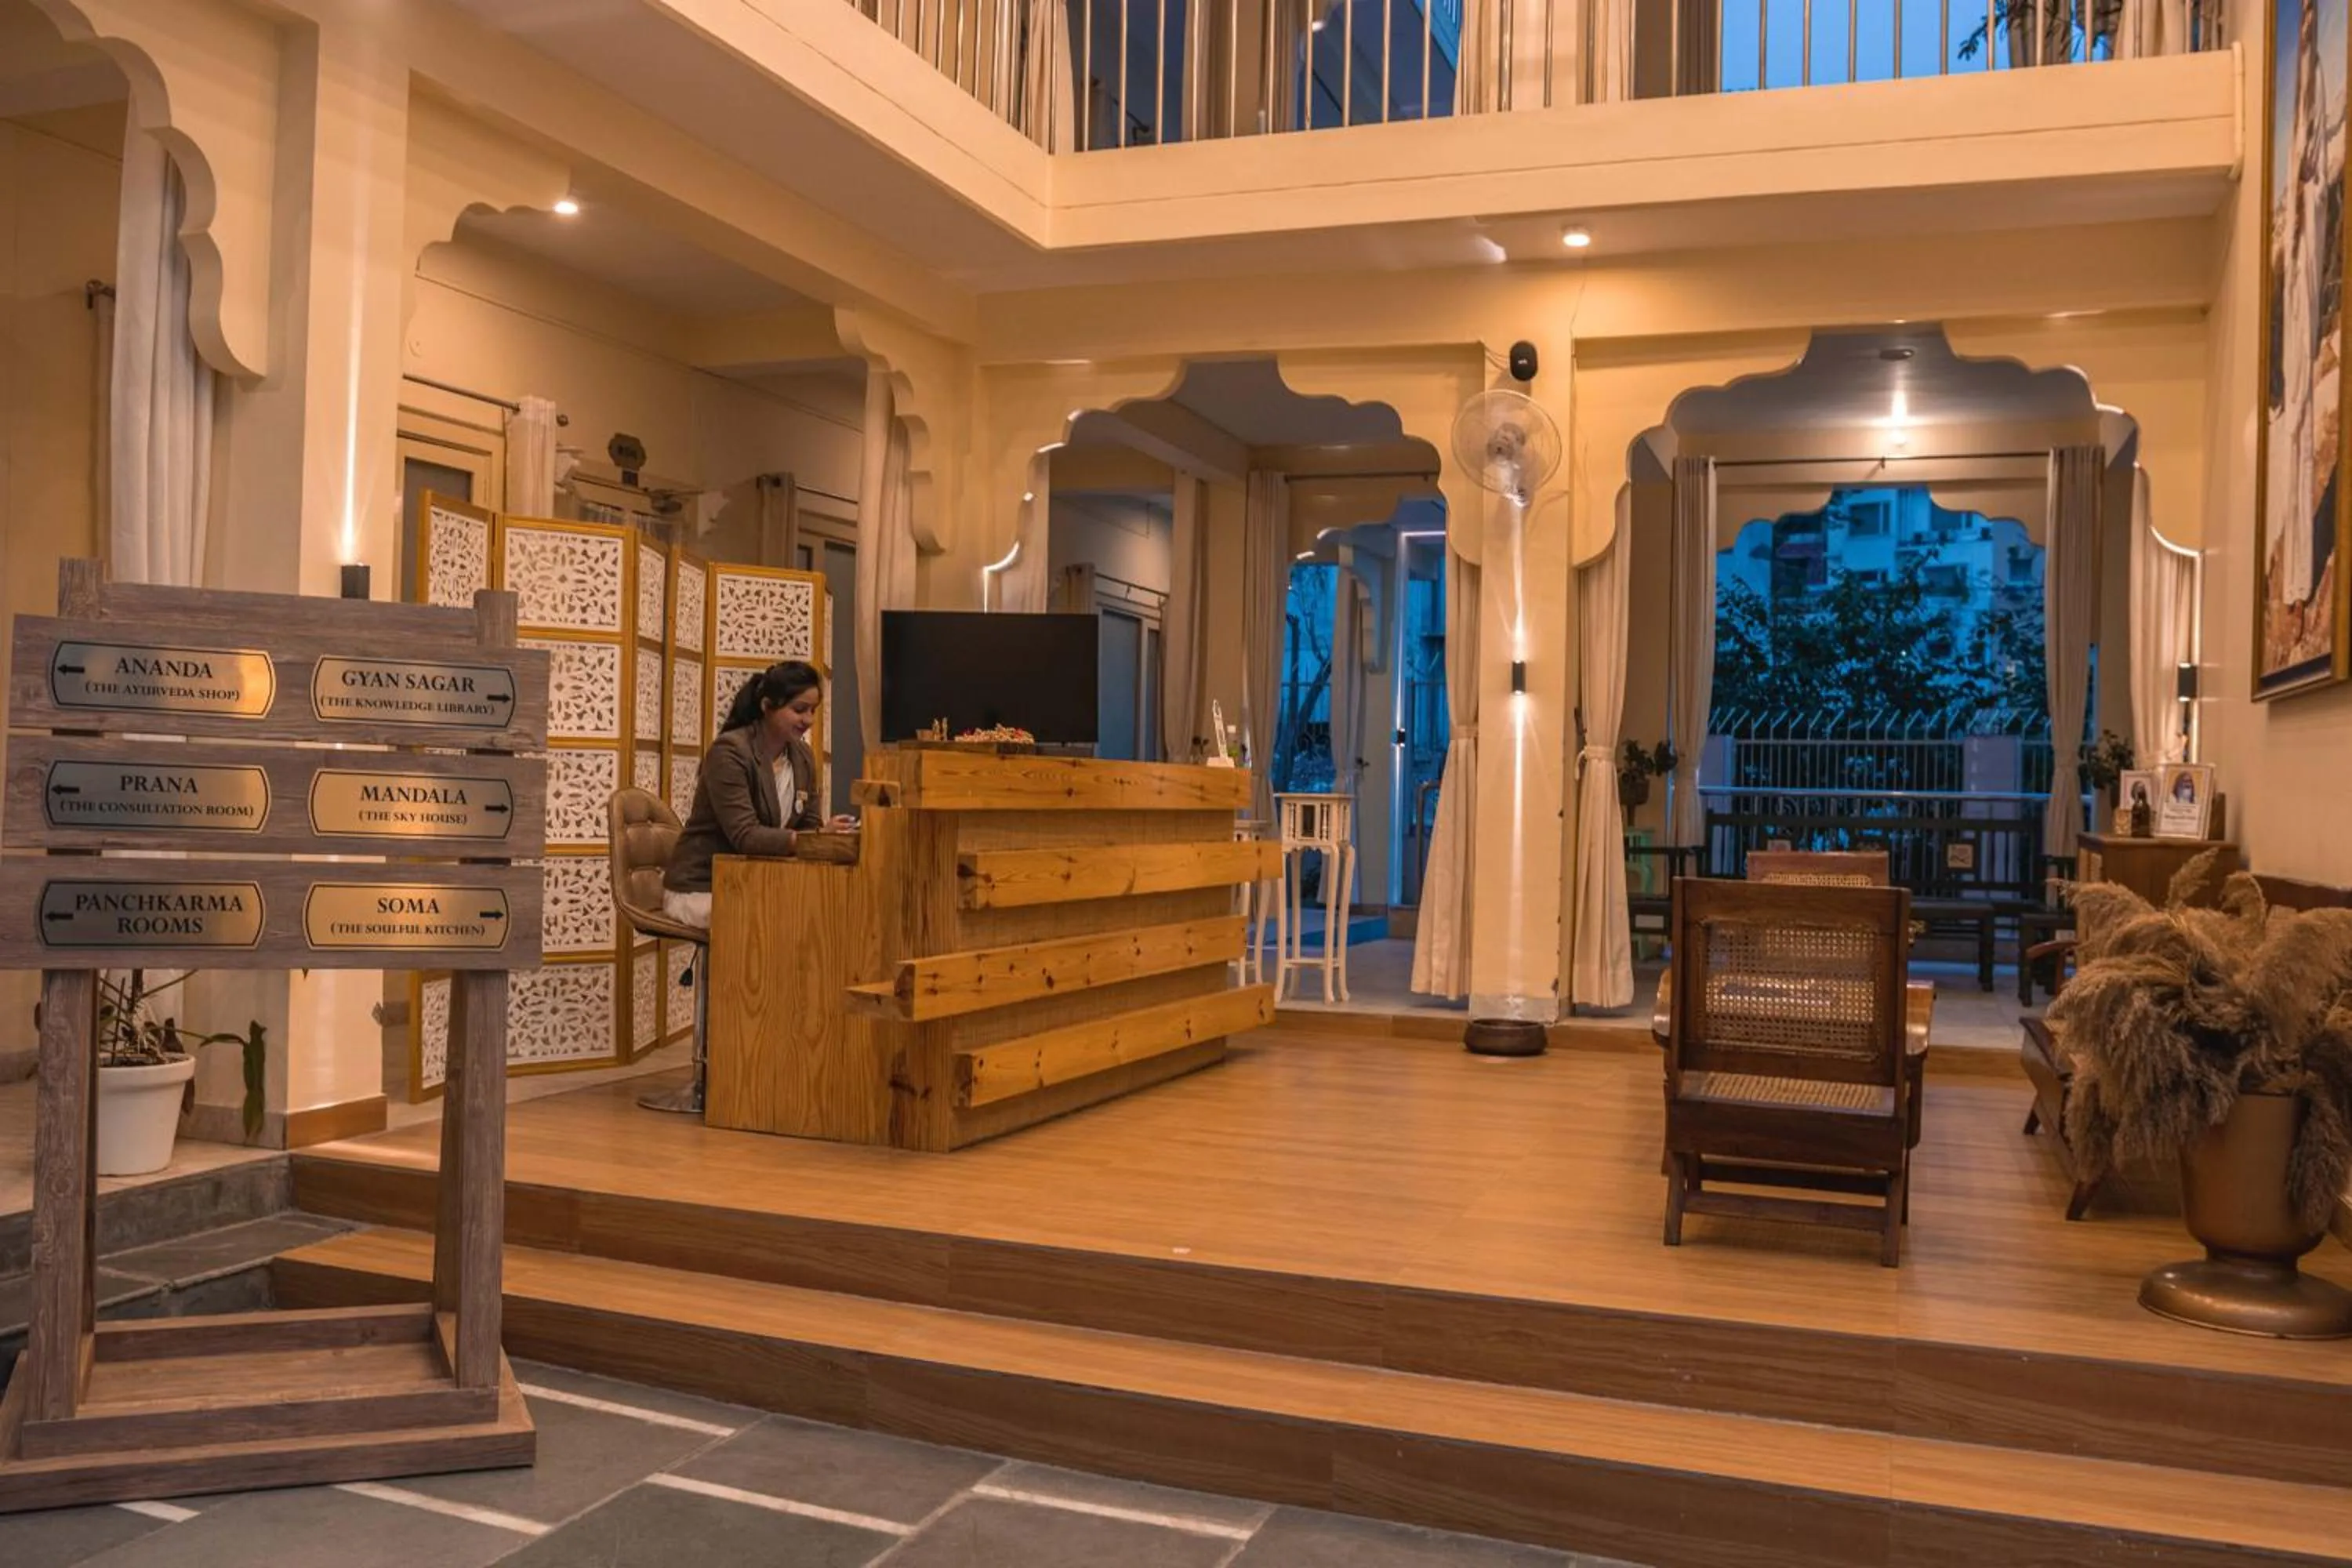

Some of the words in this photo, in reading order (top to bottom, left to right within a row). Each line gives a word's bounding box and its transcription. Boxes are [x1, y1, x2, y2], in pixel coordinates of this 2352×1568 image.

[114, 657, 213, 679] ANANDA
[341, 669, 400, 688] GYAN
[405, 673, 476, 693] SAGAR
[85, 681, 118, 695] (THE
[125, 683, 195, 699] AYURVEDA
[198, 688, 240, 702] SHOP)
[321, 695, 353, 707] (THE
[355, 697, 434, 711] KNOWLEDGE
[437, 702, 495, 716] LIBRARY)
[120, 775, 198, 793] PRANA
[360, 786, 467, 805] MANDALA
[60, 800, 96, 813] (THE
[98, 801, 202, 815] CONSULTATION
[205, 804, 254, 818] ROOM)
[358, 811, 391, 822] (THE
[393, 812, 416, 823] SKY
[420, 813, 468, 826] HOUSE)
[75, 894, 243, 913] PANCHKARMA
[376, 898, 441, 915] SOMA
[118, 917, 204, 935] ROOMS
[330, 923, 364, 935] (THE
[365, 924, 421, 935] SOULFUL
[426, 924, 486, 936] KITCHEN)
